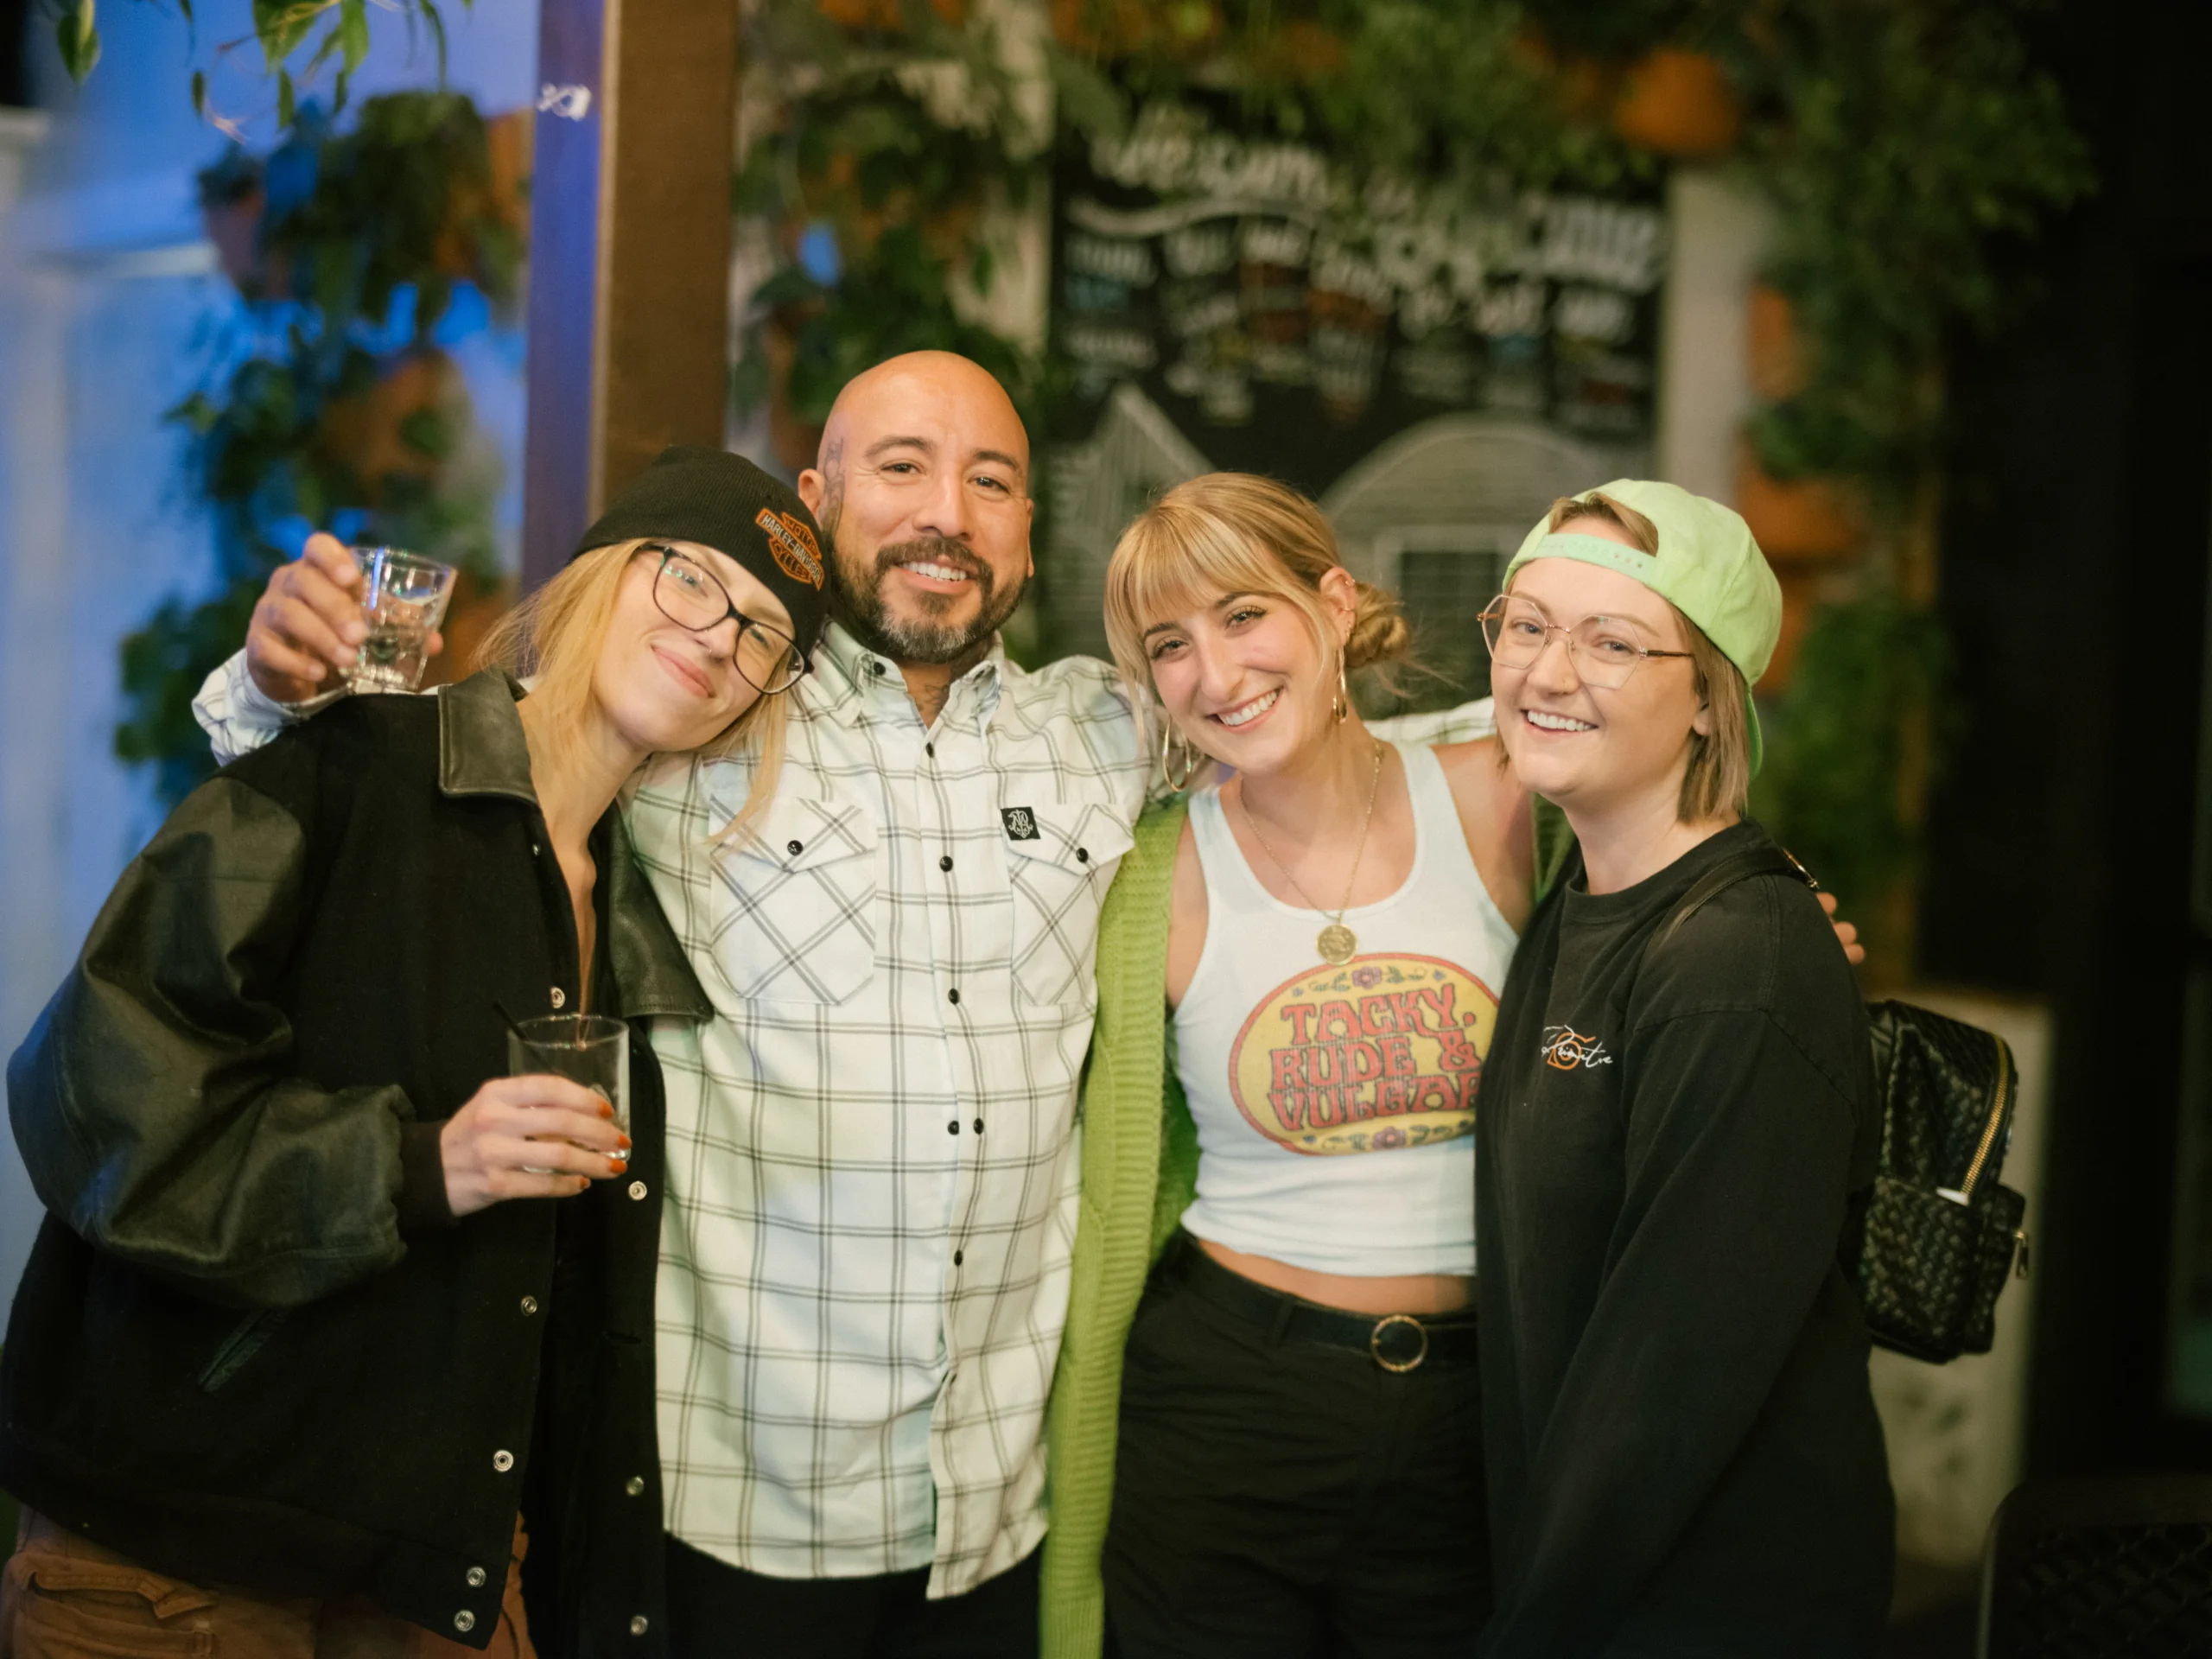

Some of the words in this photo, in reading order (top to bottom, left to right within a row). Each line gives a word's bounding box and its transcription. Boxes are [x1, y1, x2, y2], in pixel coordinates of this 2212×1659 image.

[761, 514, 822, 583] HARLEY-DAVIDSON
[774, 542, 808, 578] CYCLES
[1269, 1036, 1417, 1091] RUDE
[1437, 1027, 1482, 1073] &
